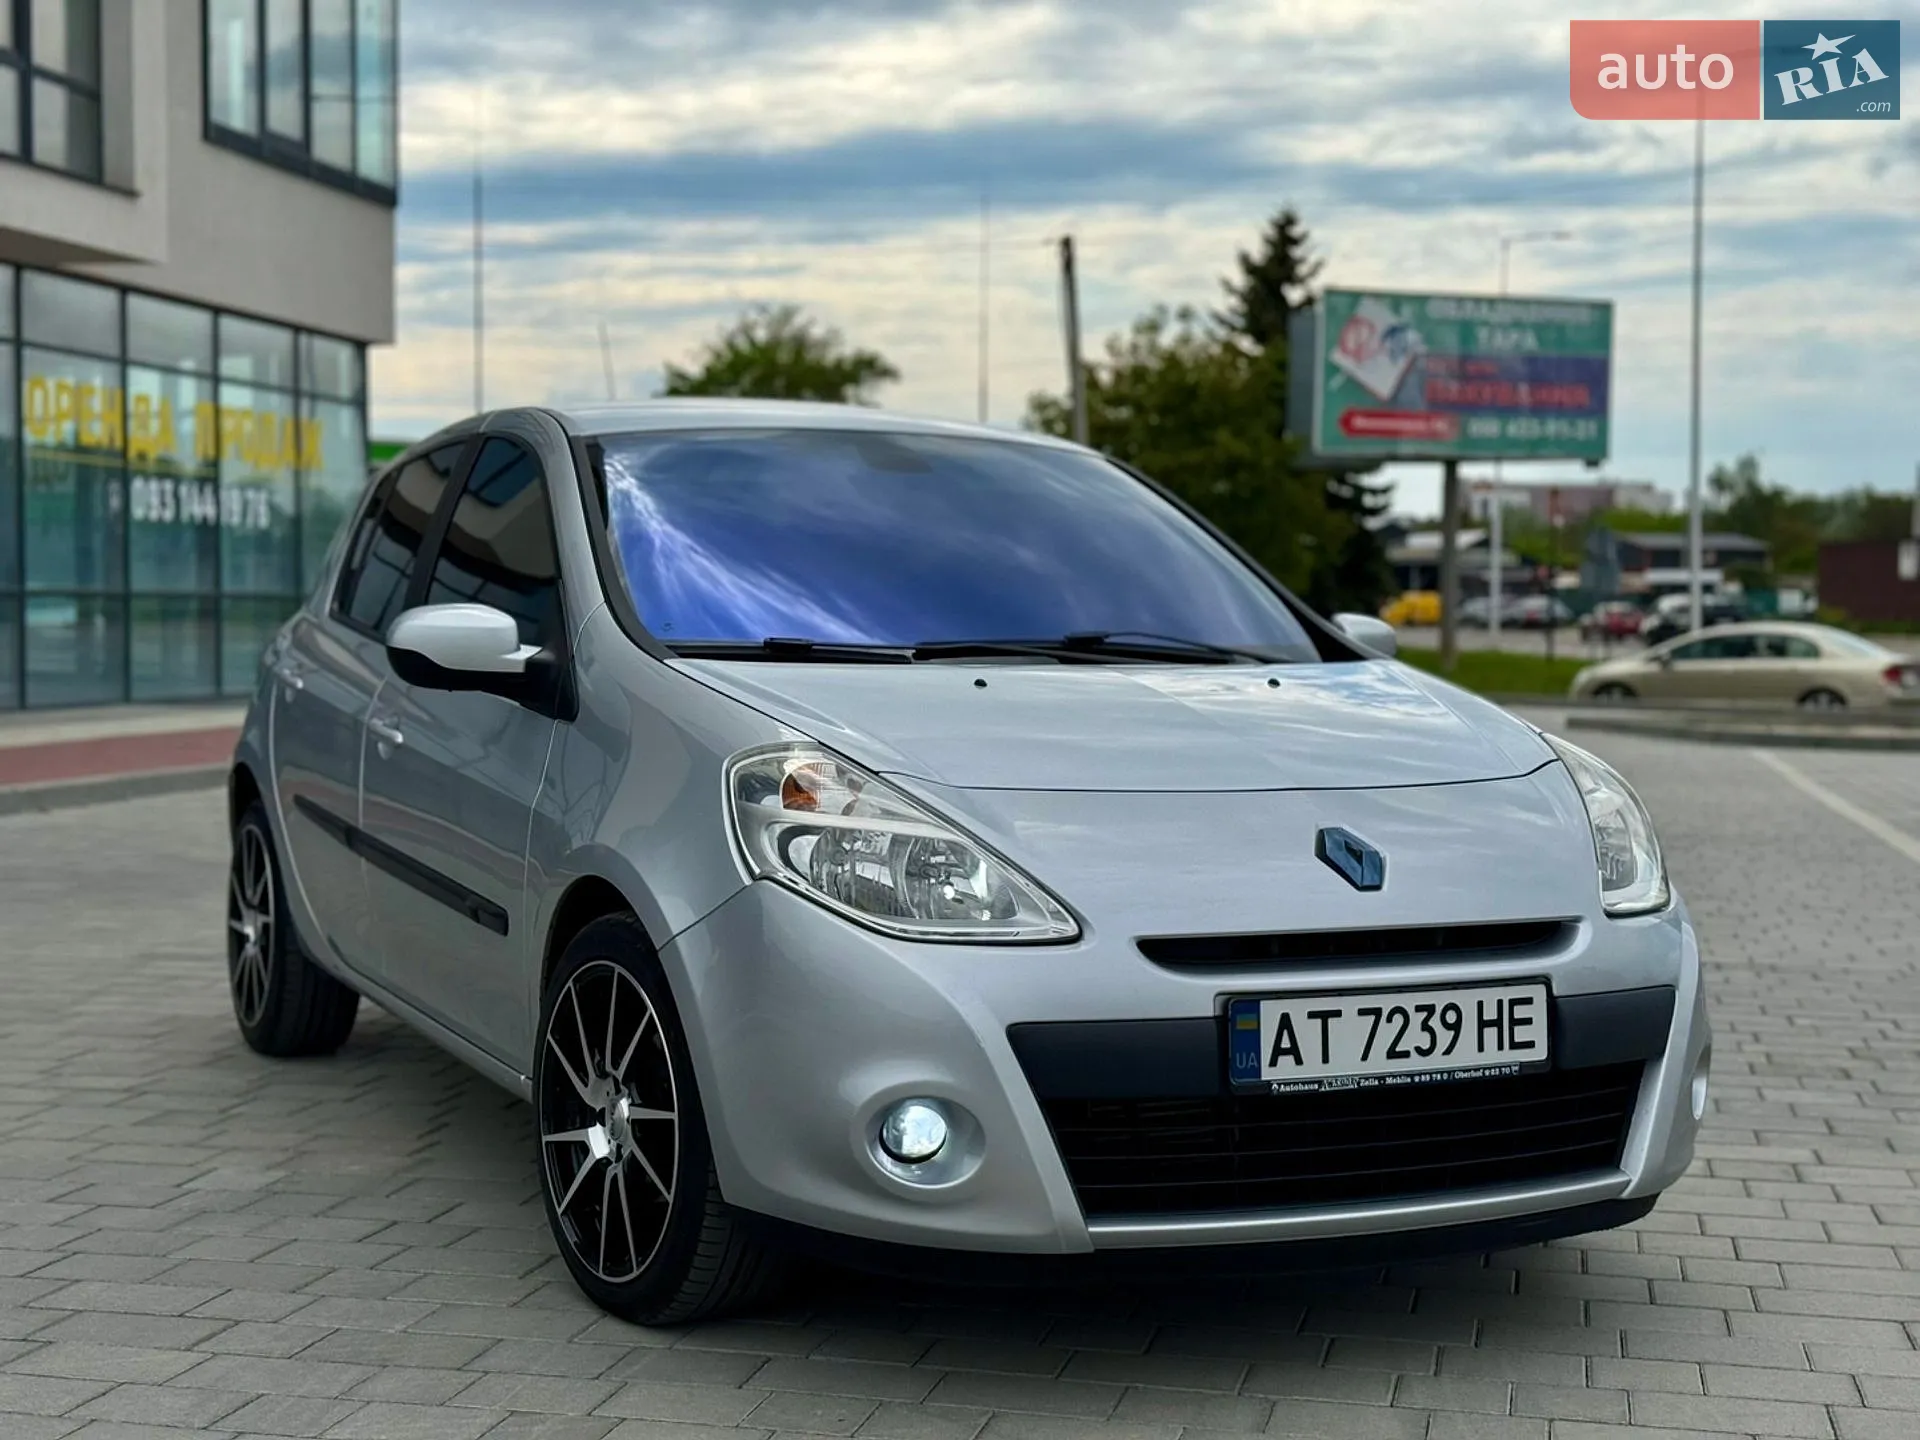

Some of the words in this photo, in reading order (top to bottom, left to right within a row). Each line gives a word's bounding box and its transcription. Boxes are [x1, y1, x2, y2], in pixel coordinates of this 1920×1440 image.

[1268, 1009, 1343, 1068] AT
[1357, 1002, 1463, 1062] 7239
[1476, 996, 1536, 1053] HE
[1235, 1054, 1259, 1069] UA
[1279, 1083, 1319, 1093] Autohaus
